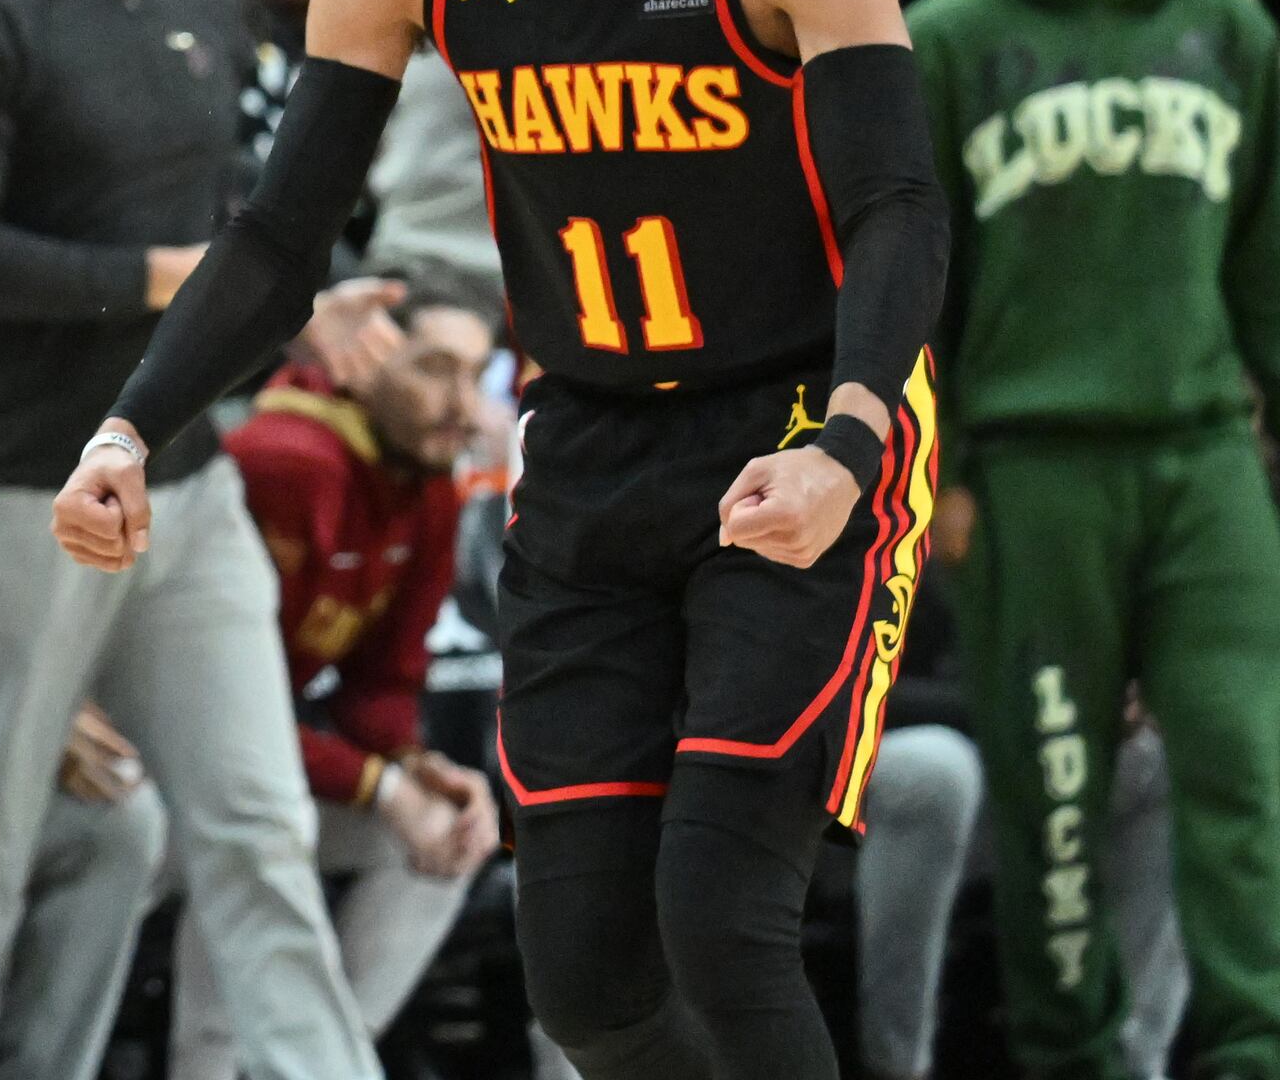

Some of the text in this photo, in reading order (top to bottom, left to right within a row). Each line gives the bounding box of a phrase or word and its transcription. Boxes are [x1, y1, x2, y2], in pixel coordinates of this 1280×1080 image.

[458, 61, 750, 154] HAWKS
[961, 74, 1243, 222] LUCKY
[557, 215, 705, 355] 11
[1031, 663, 1091, 993] LUCKY
